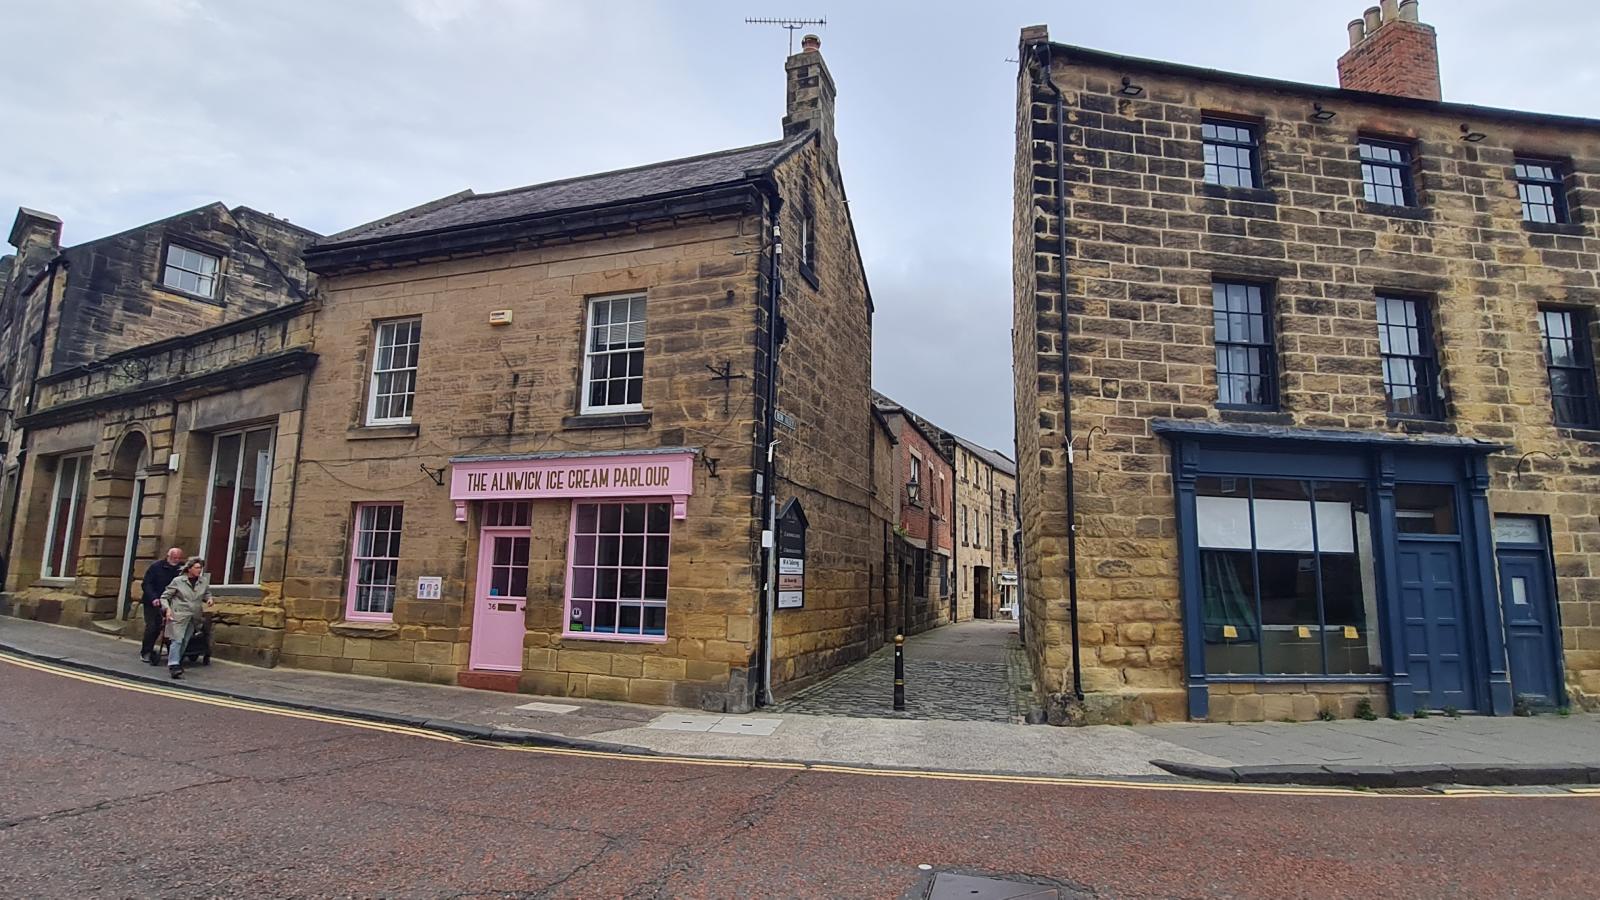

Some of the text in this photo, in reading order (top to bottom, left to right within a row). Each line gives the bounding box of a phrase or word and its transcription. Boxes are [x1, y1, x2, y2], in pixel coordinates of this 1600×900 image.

[468, 466, 670, 491] THE ALNWICK ICE CREAM PARLOUR
